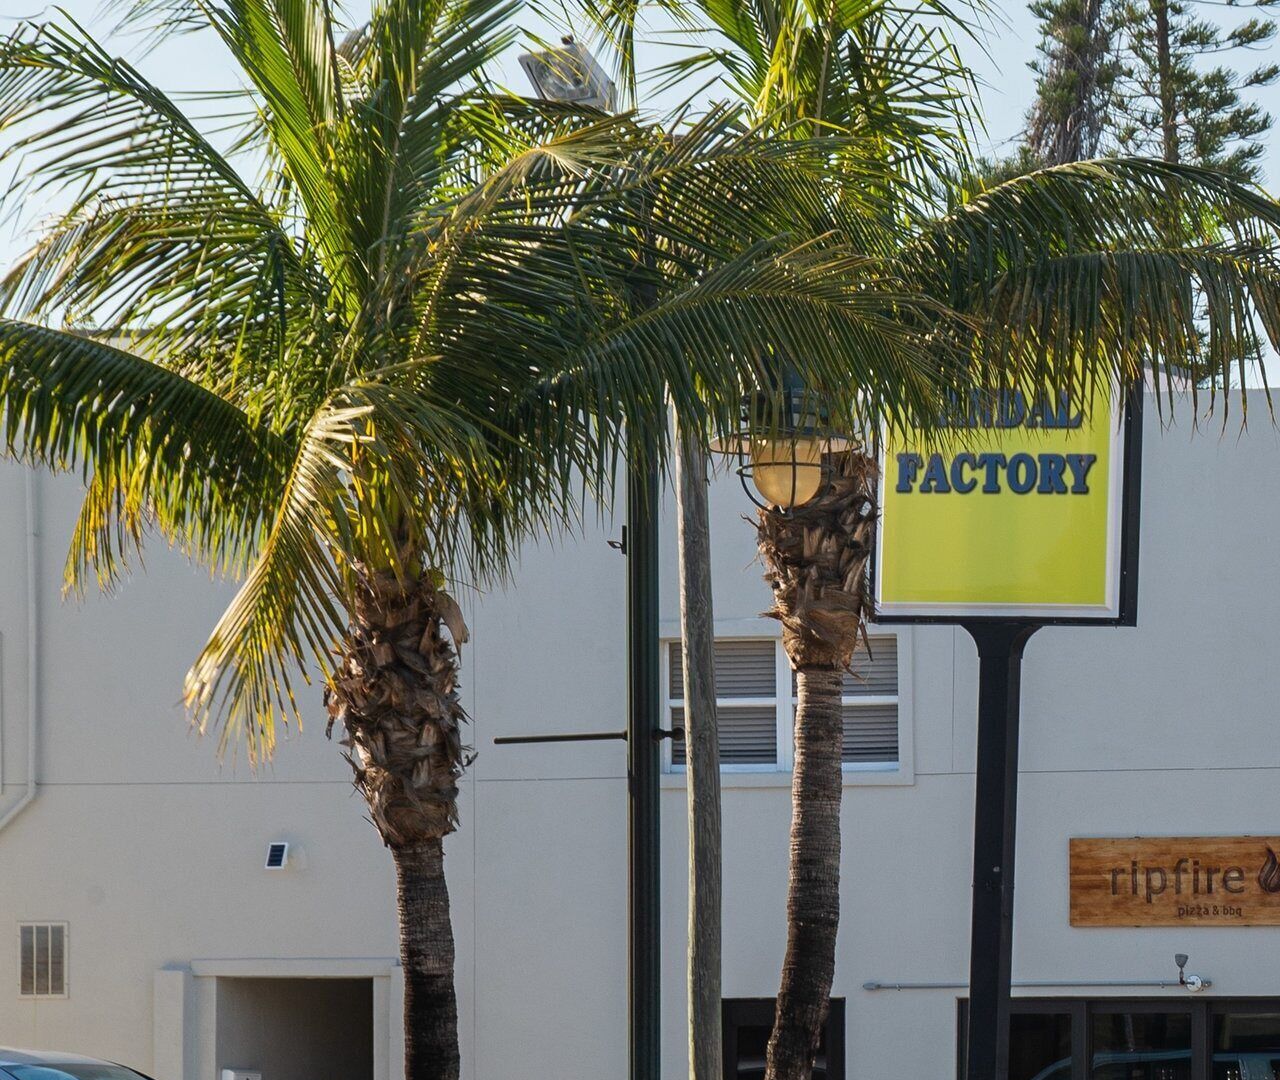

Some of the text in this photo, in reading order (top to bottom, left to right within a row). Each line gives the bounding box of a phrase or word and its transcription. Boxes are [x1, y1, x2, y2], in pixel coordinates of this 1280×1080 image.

[911, 386, 1082, 429] ANDAL
[895, 453, 1097, 495] FACTORY
[1110, 857, 1245, 903] ripfire
[1178, 904, 1242, 918] pizza & bbq
